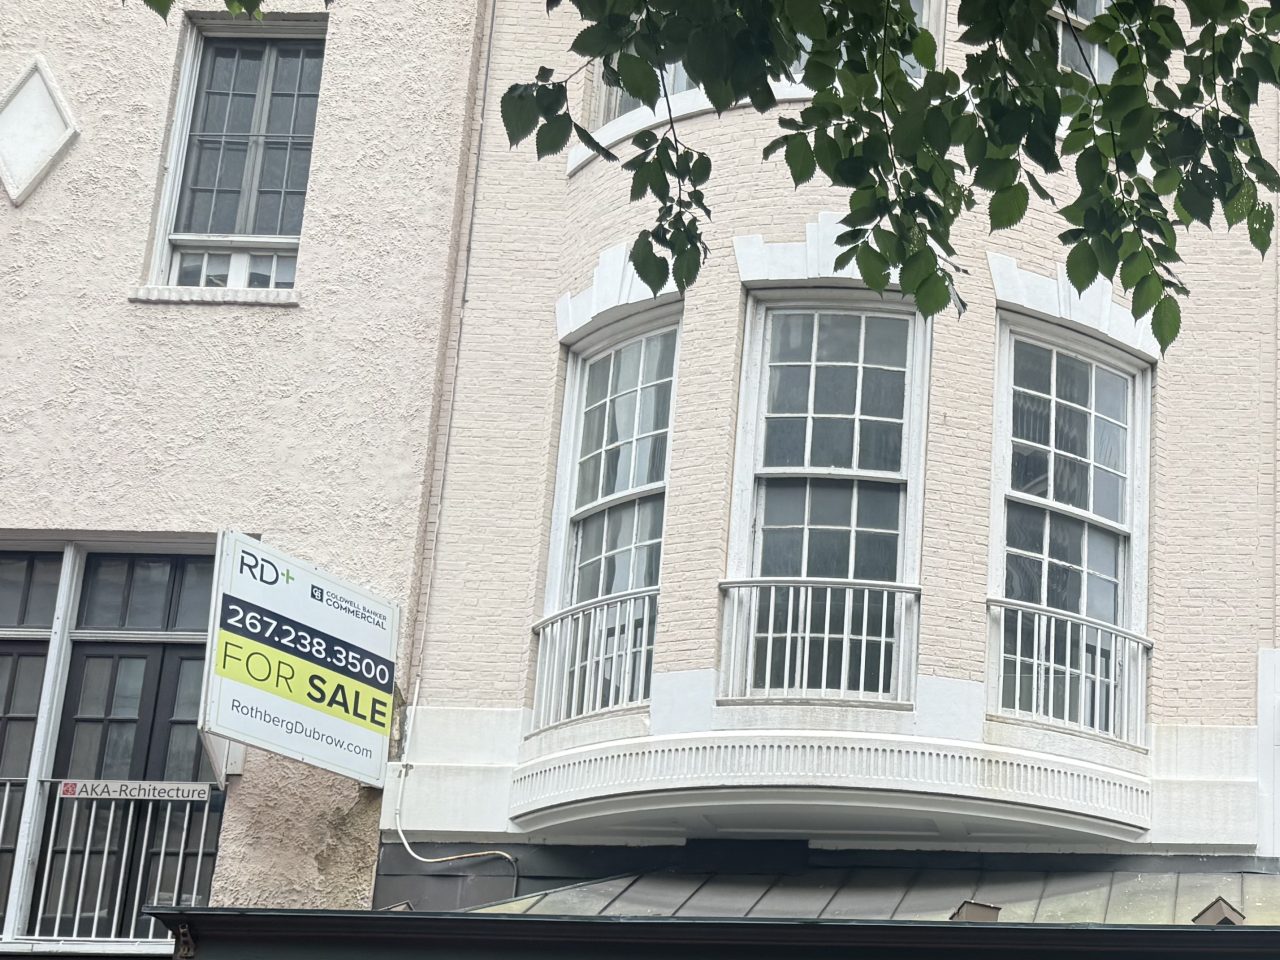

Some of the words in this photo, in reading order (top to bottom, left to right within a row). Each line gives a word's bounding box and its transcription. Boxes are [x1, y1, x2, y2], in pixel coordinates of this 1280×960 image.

[325, 598, 387, 630] COMMERCIAL
[326, 590, 361, 610] COLDWELL
[362, 606, 387, 622] BANKER
[226, 604, 389, 685] 267.238.3500
[222, 641, 296, 693] FOR
[306, 674, 388, 728] SALE
[231, 699, 373, 759] RothbergDubrow.com
[78, 783, 207, 799] AKA-Rchitecture
